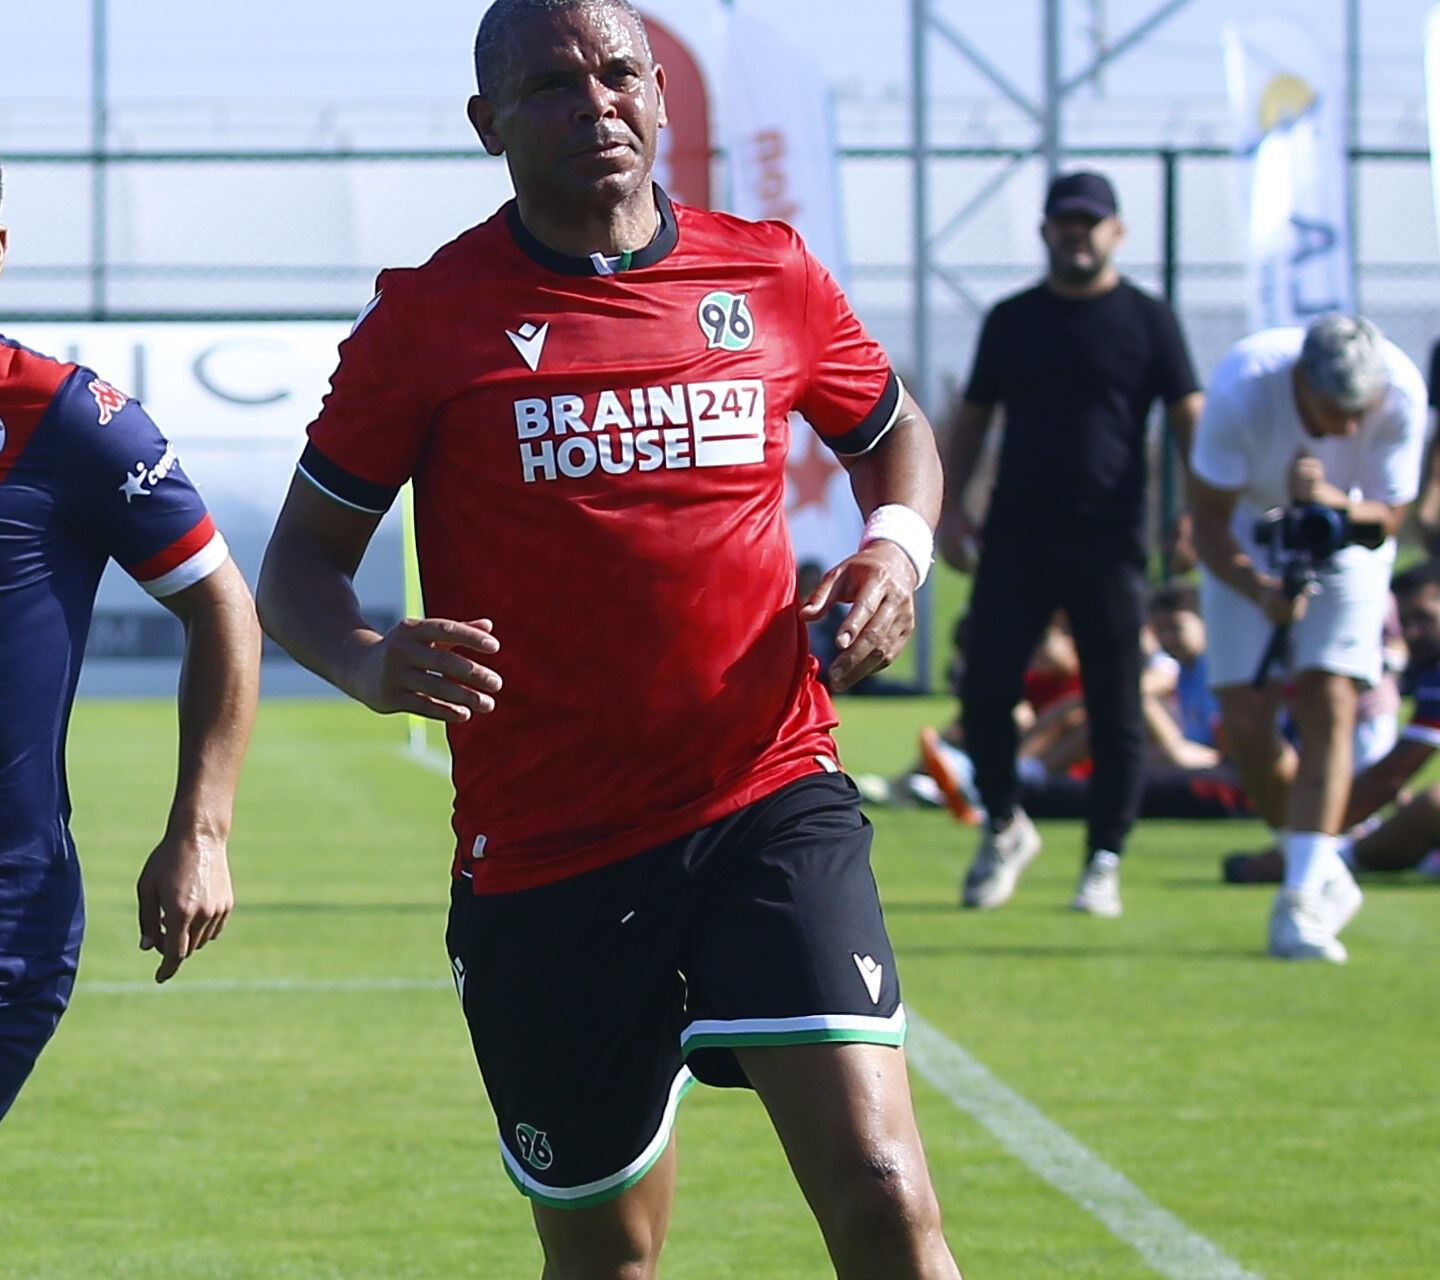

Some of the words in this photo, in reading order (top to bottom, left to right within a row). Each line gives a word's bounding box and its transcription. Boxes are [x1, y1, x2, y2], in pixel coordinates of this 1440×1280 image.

[700, 298, 751, 345] 96
[514, 384, 688, 439] BRAIN
[696, 386, 758, 421] 247
[520, 427, 690, 482] HOUSE
[516, 1124, 552, 1167] 96
